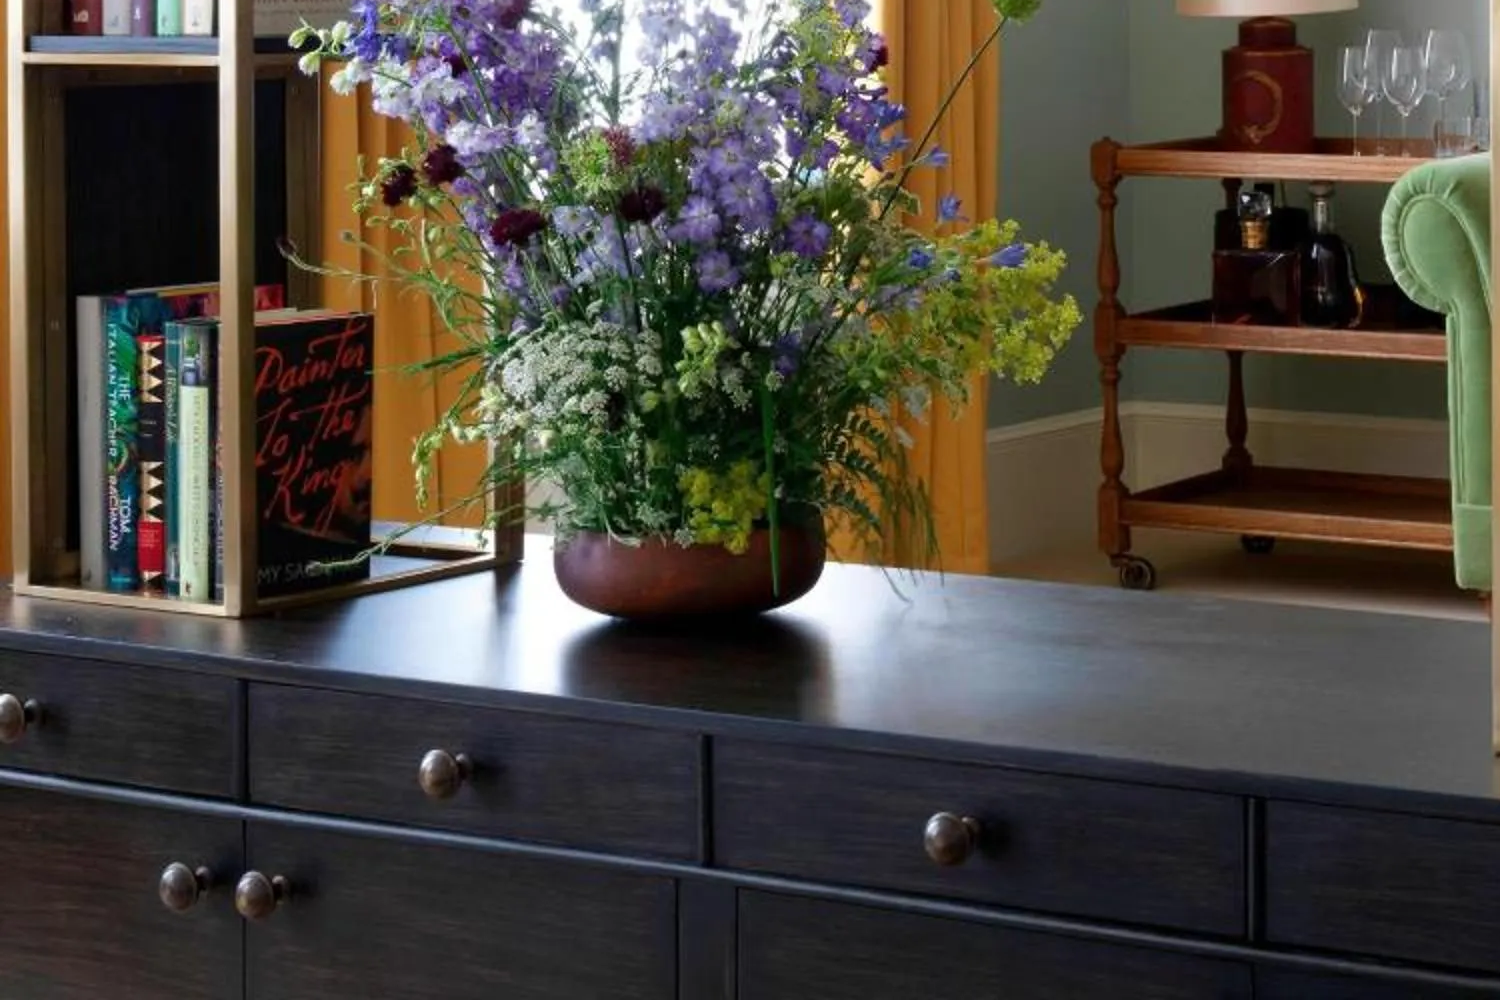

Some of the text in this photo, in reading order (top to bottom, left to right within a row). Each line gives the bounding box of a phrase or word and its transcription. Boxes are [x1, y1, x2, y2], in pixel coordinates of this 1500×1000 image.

[106, 322, 118, 458] ITALIAN TEACHER
[117, 374, 132, 402] THE
[107, 474, 120, 551] RACHMAN
[119, 497, 133, 534] TOM
[263, 444, 352, 537] King
[256, 566, 279, 585] MY
